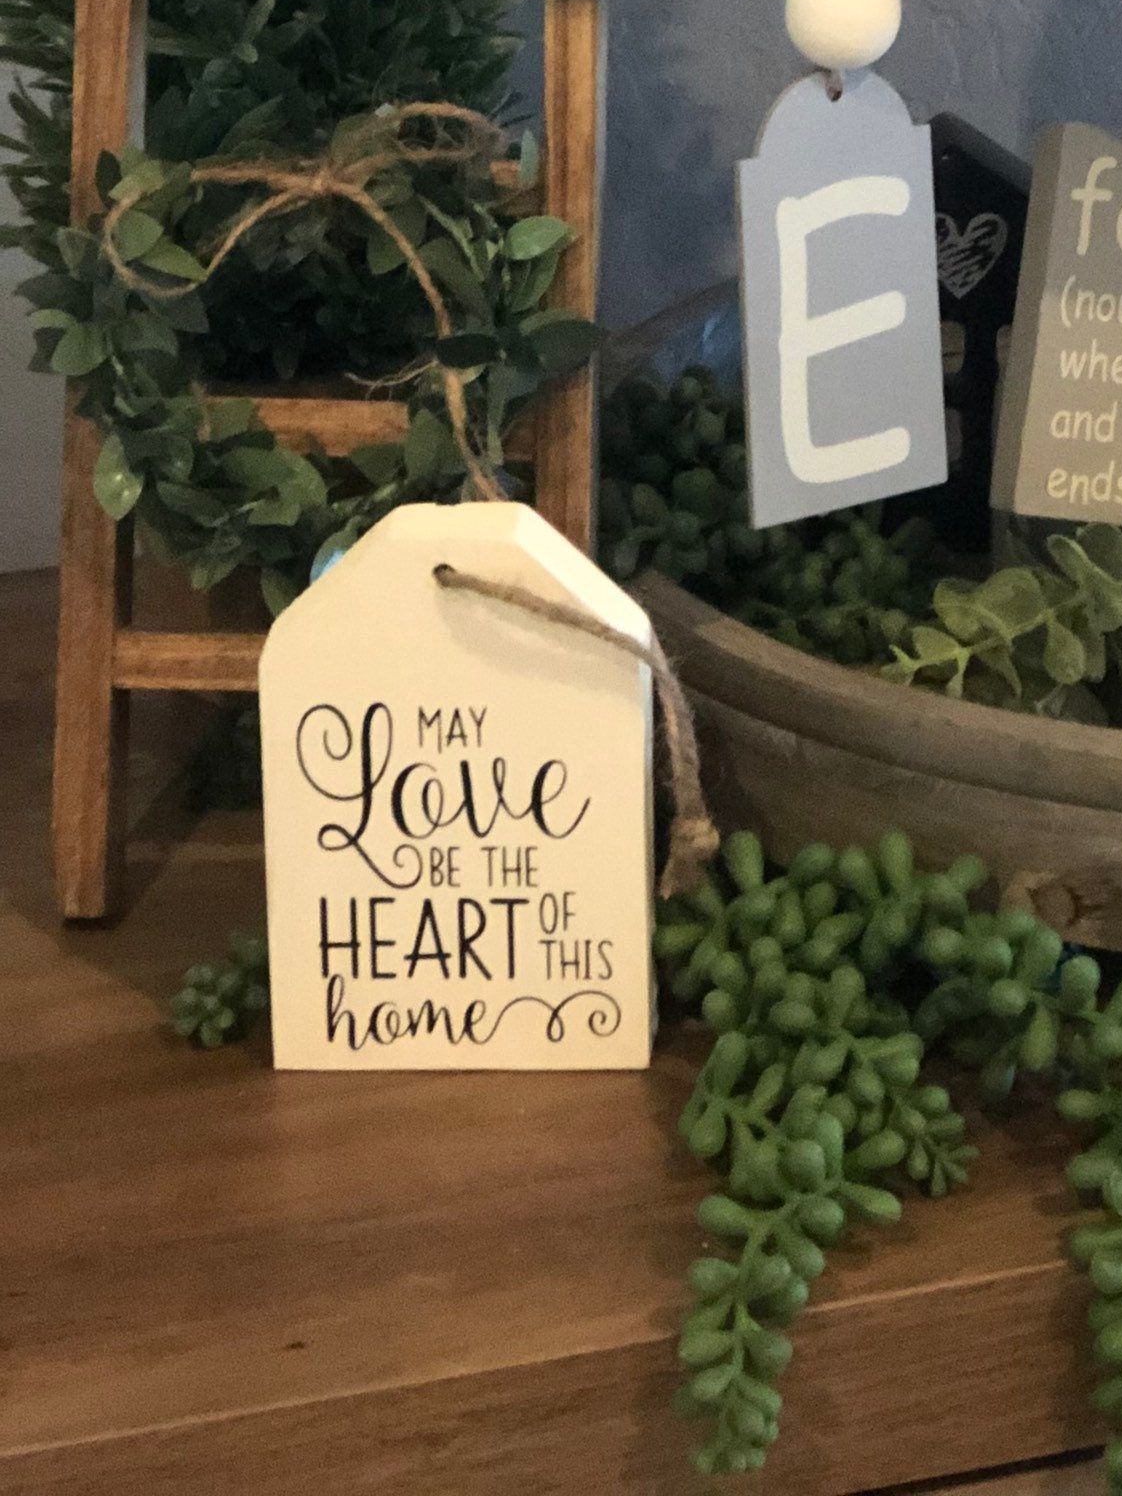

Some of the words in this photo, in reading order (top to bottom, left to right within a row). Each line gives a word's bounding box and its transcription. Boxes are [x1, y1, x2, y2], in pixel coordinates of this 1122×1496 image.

[776, 175, 911, 484] E
[1050, 401, 1118, 444] and
[418, 705, 488, 754] MAY
[296, 702, 591, 889] Love
[429, 845, 461, 888] BE
[481, 845, 539, 888] THE
[319, 896, 530, 981] HEART
[539, 891, 576, 935] OF
[538, 938, 614, 981] THIS
[326, 973, 505, 1051] home
